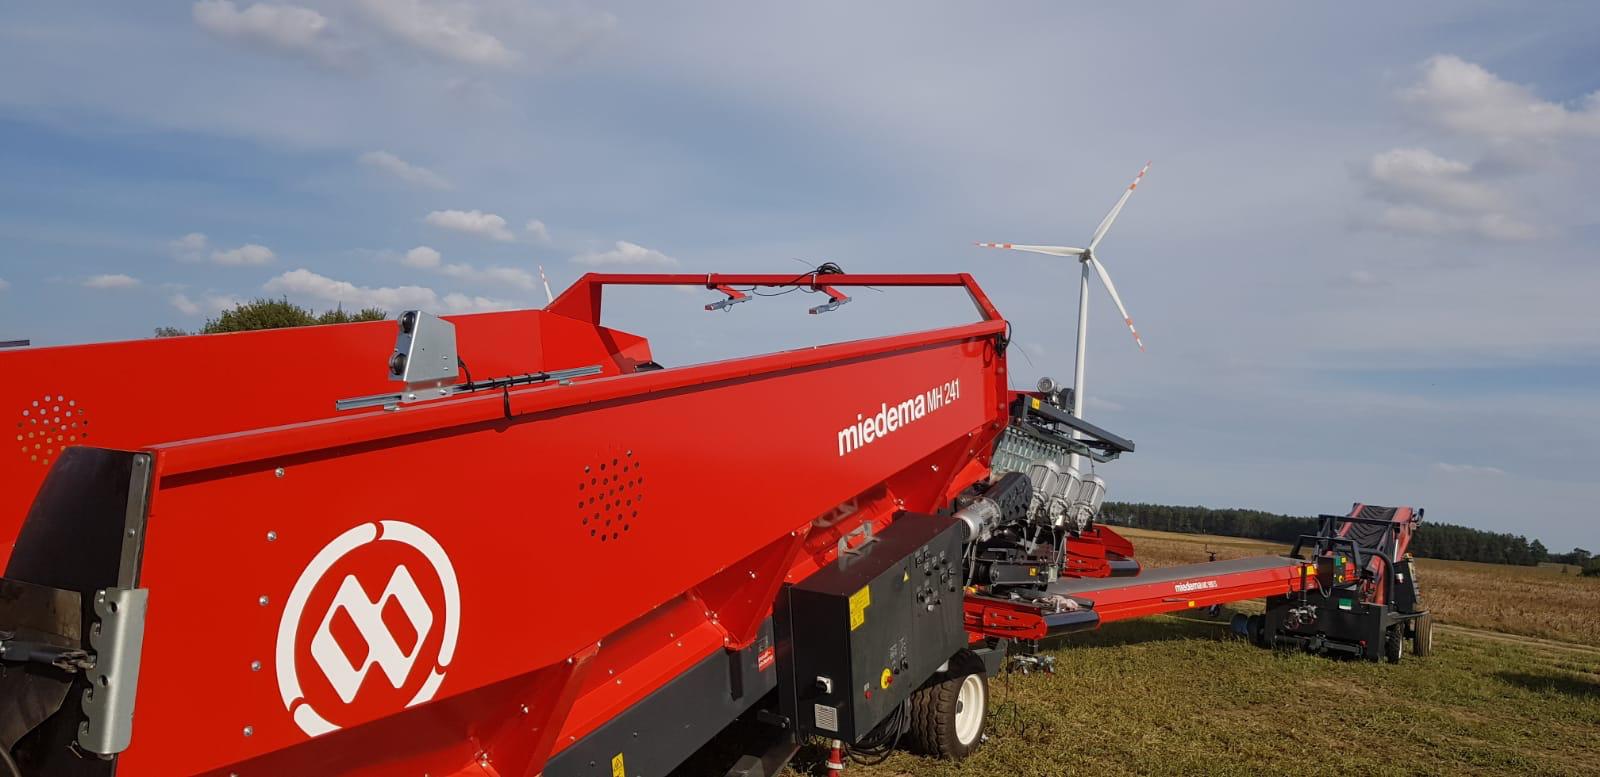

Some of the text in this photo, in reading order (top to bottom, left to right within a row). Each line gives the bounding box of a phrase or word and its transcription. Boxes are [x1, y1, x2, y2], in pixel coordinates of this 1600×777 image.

[838, 378, 960, 456] miedema MH 241
